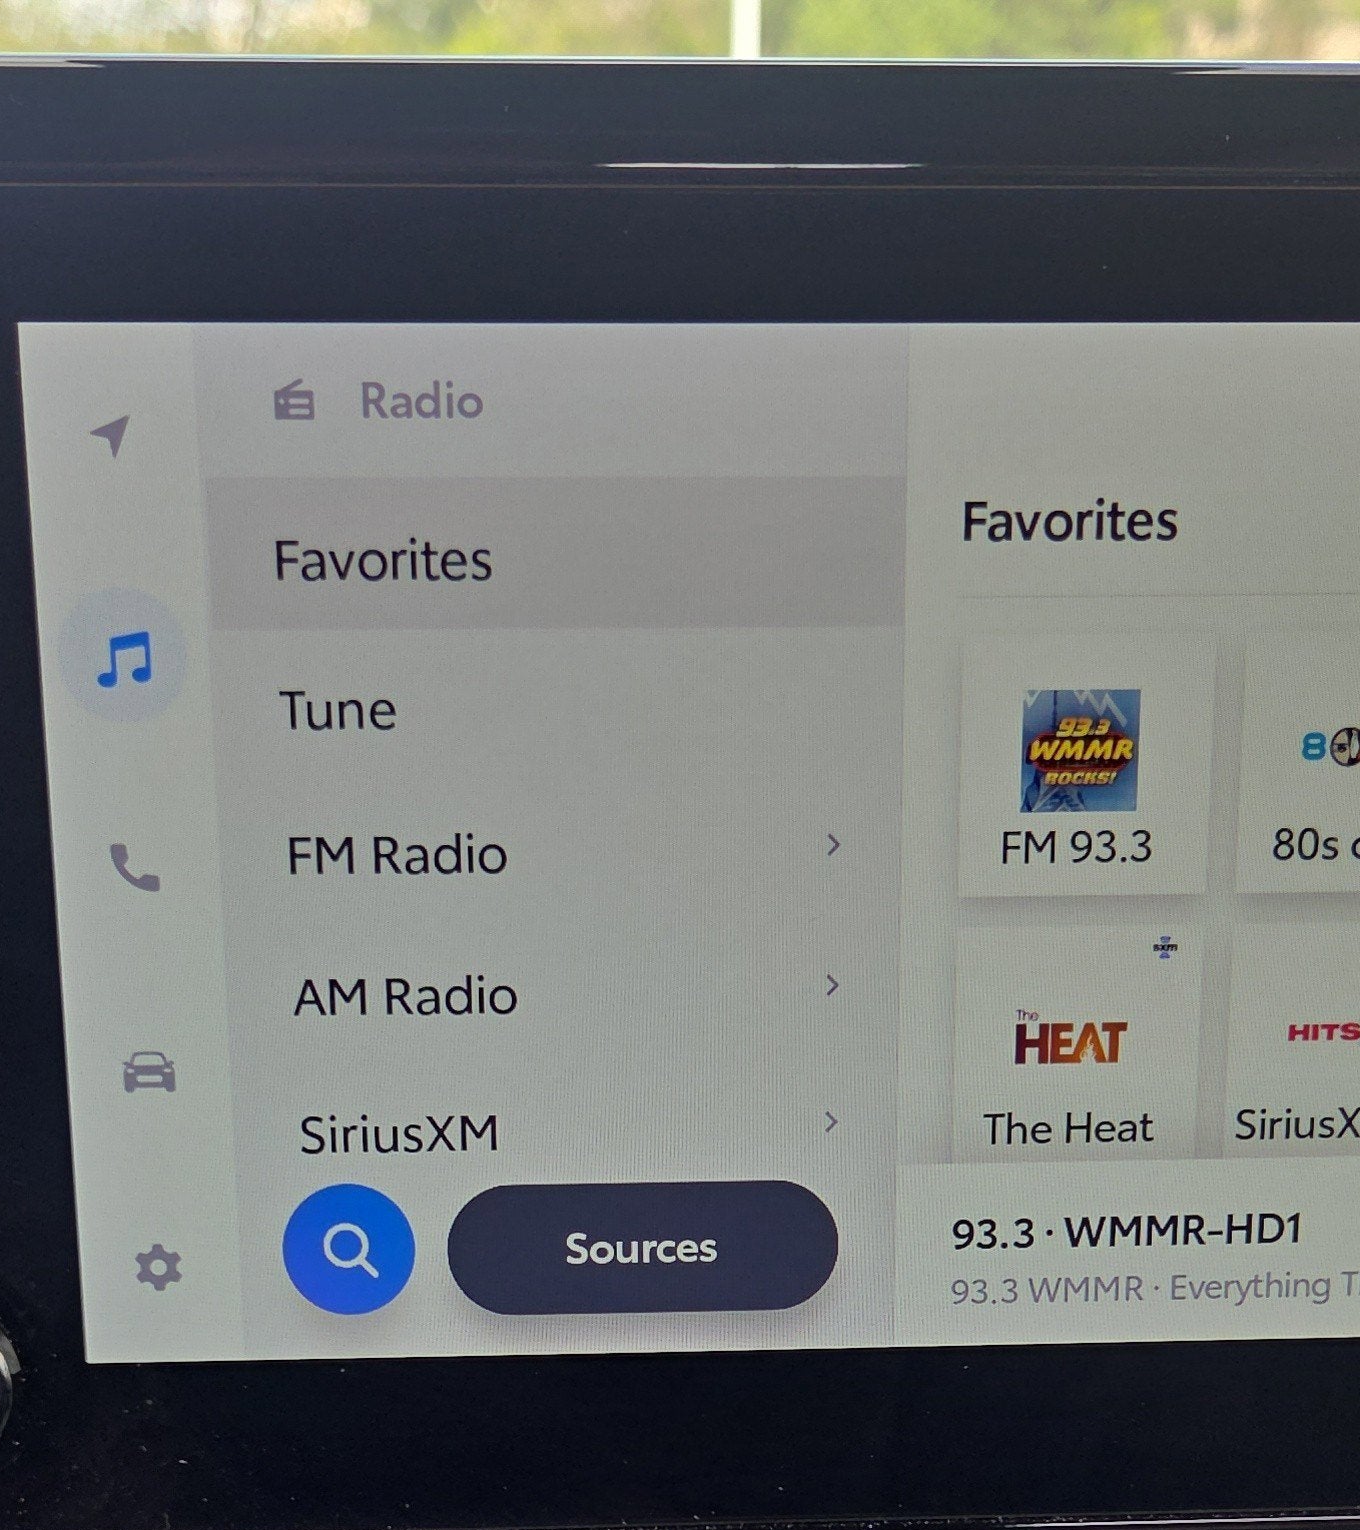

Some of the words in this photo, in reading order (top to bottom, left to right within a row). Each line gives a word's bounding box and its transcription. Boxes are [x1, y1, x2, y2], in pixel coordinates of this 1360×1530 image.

[361, 380, 484, 421] Radio
[962, 497, 1178, 544] Favorites
[274, 536, 493, 583] Favorites
[280, 690, 398, 732] Tune
[1056, 716, 1112, 738] 93.3
[1029, 738, 1135, 761] WMMR
[1044, 771, 1118, 786] ROCKS!
[288, 834, 354, 875] FM
[373, 832, 508, 875] Radio
[1001, 830, 1057, 865] FM
[1070, 829, 1153, 863] 93.3
[1272, 827, 1340, 861] 80s
[292, 978, 368, 1017] AM
[384, 974, 519, 1017] Radio
[1015, 1008, 1040, 1022] The
[1014, 1021, 1129, 1065] HEAT
[300, 1114, 500, 1156] SiriusXM
[983, 1111, 1053, 1146] The
[1065, 1111, 1155, 1144] Heat
[565, 1231, 718, 1266] Sources
[951, 1217, 1036, 1251] 93.3
[1064, 1212, 1302, 1249] WMMR-HD1
[950, 1278, 1019, 1306] 93.3
[1028, 1276, 1144, 1304] WMMR
[1170, 1272, 1331, 1306] Everything
